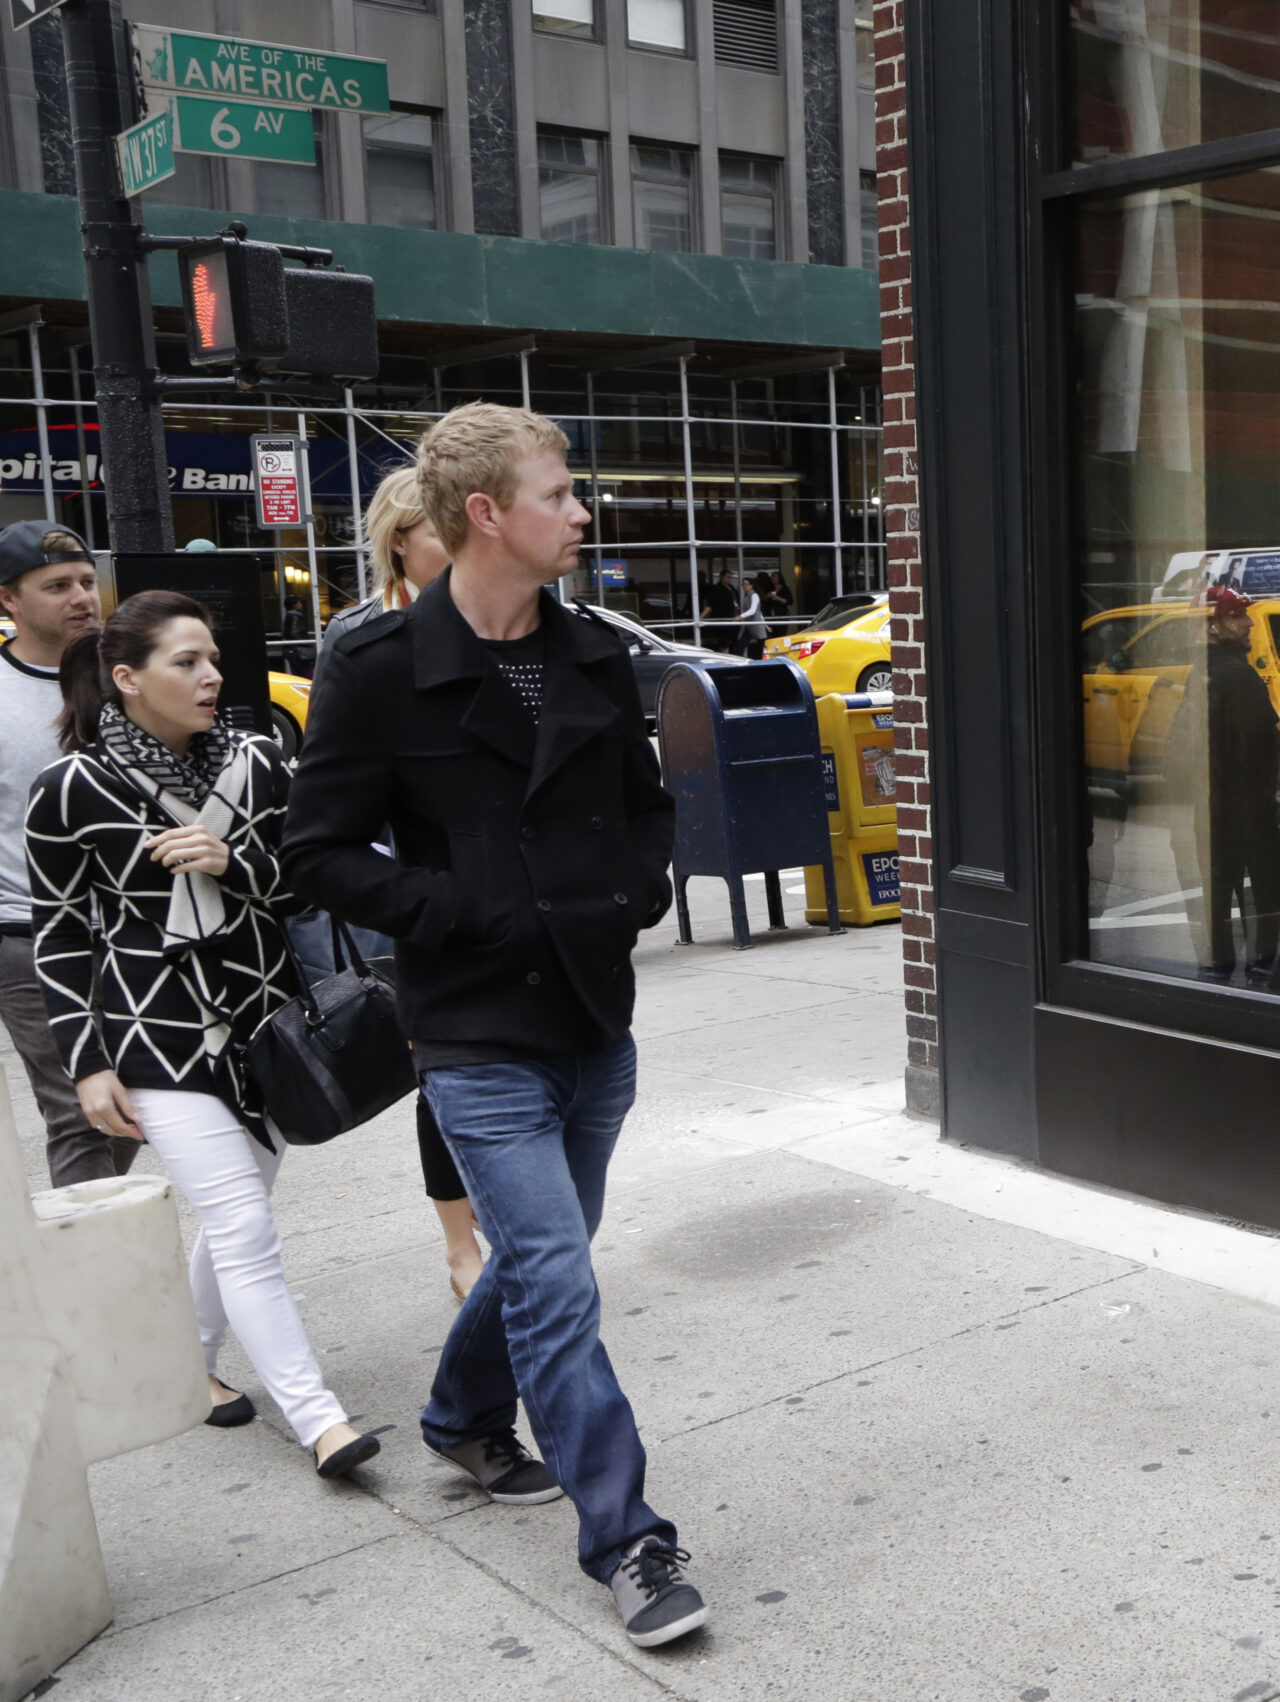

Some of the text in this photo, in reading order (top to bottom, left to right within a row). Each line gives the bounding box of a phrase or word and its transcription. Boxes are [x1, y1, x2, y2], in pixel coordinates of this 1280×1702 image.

[217, 42, 327, 73] AVE OF THE
[184, 57, 363, 109] AMERICAS
[129, 120, 167, 184] W 37 ST
[210, 106, 285, 150] 6 AV
